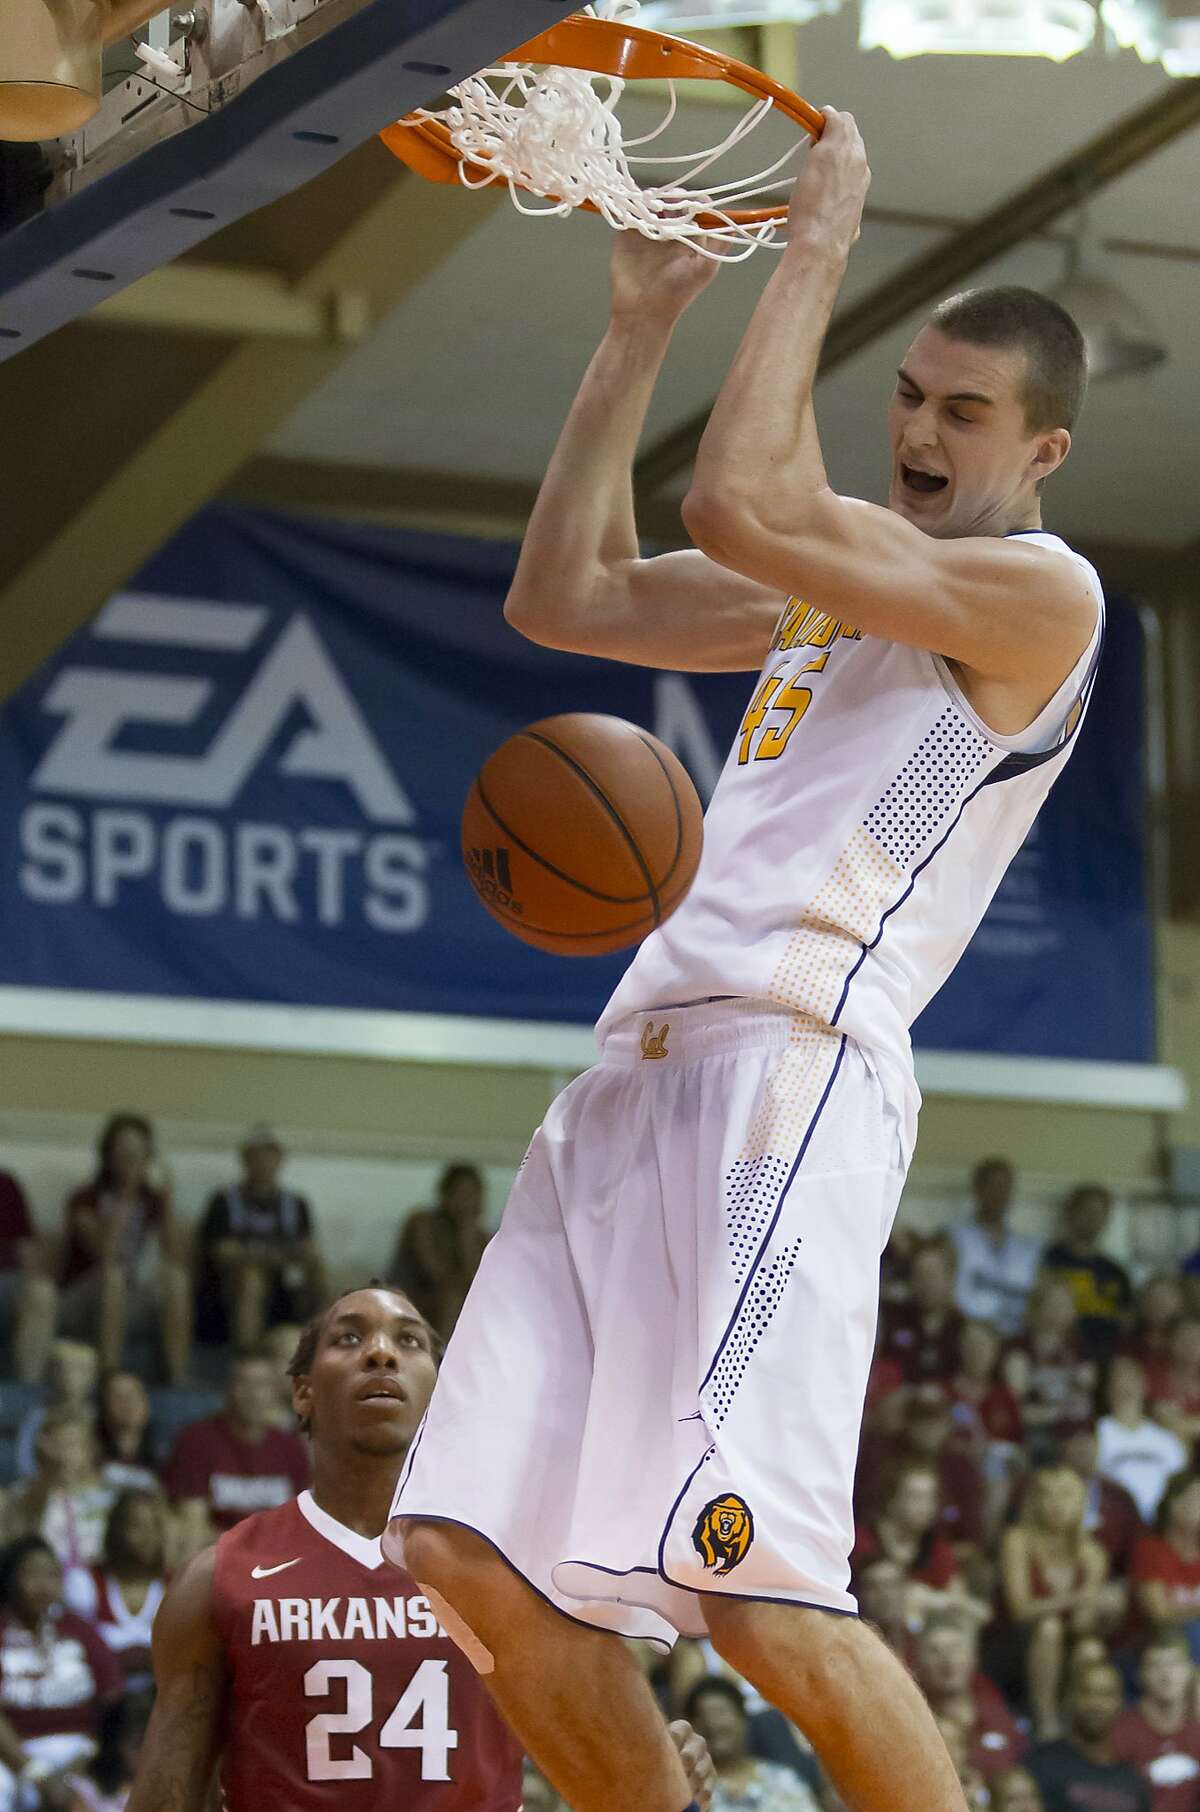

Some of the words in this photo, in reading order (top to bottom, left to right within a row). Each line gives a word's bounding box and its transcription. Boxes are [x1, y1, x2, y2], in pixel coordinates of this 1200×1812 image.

[30, 593, 415, 826] EA
[737, 651, 831, 766] 45
[19, 804, 429, 933] SPORTS
[251, 1596, 449, 1644] ARKANS
[304, 1659, 458, 1781] 24
